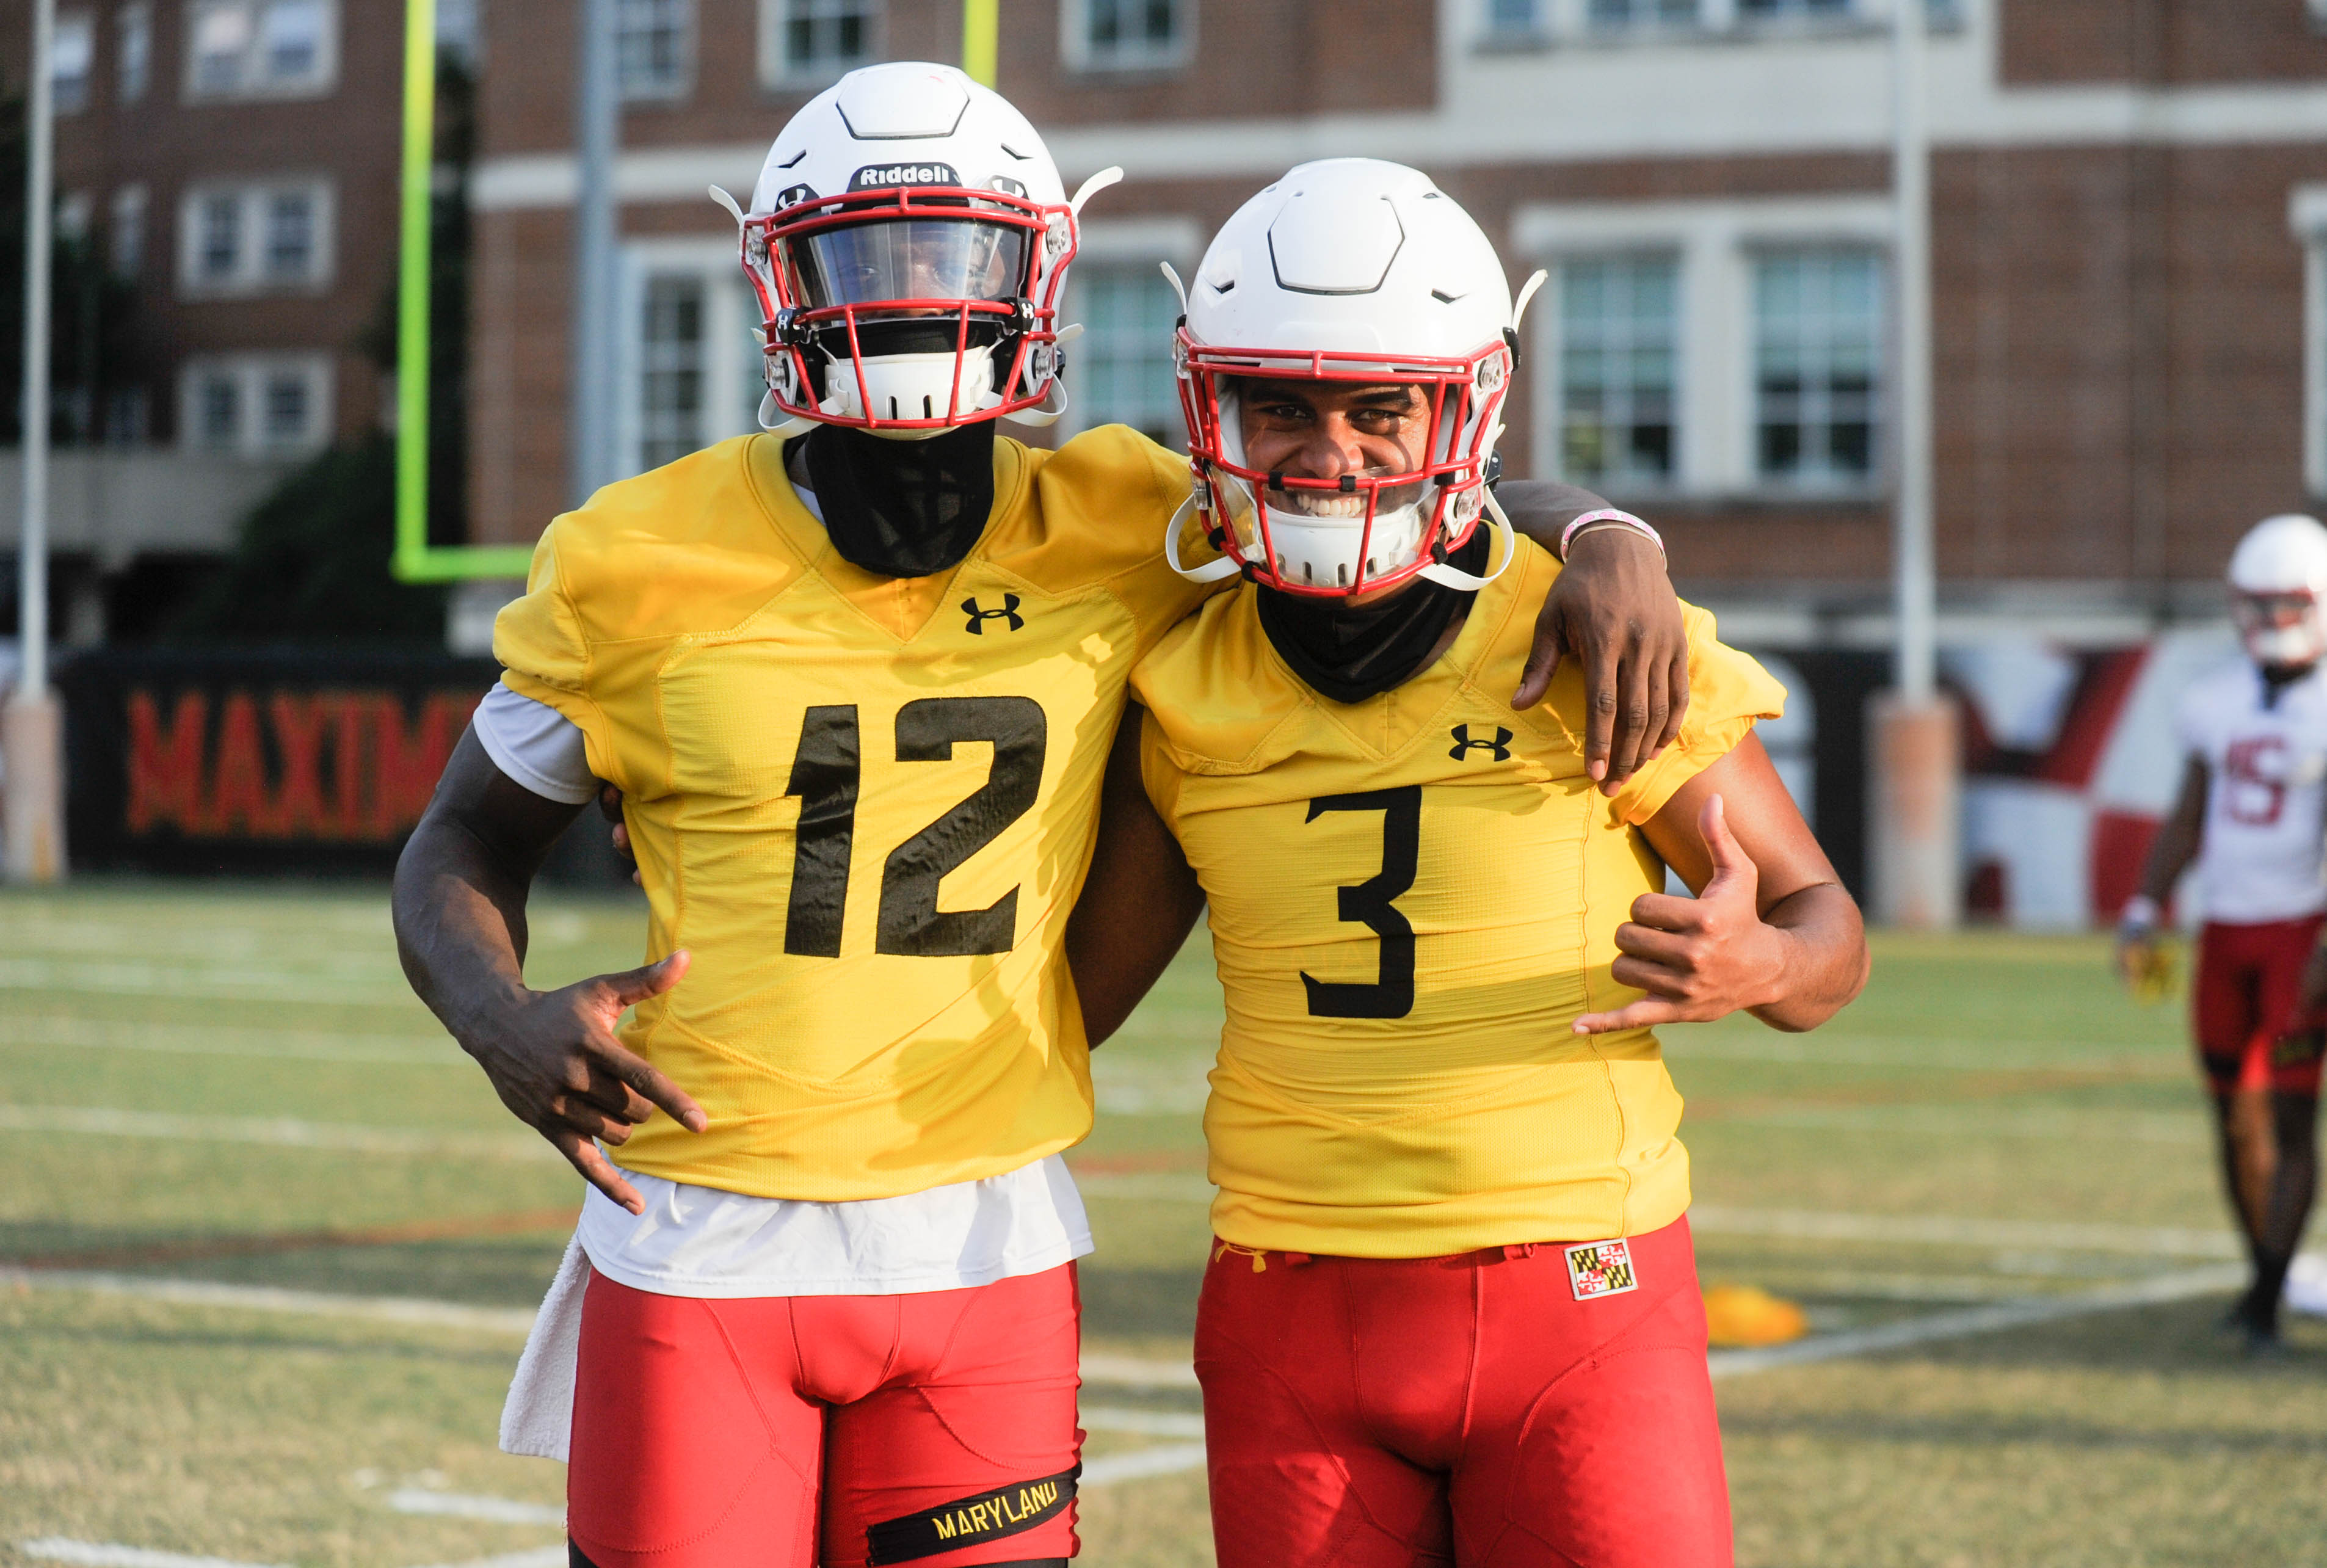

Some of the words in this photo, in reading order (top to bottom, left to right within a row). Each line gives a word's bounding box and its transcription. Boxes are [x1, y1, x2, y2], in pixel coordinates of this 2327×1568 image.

[860, 165, 949, 186] Riddell
[127, 689, 487, 840] MAXIM
[784, 696, 1047, 958] 12
[1299, 785, 1422, 1018] 3
[931, 1481, 1058, 1540] MARYLAND
